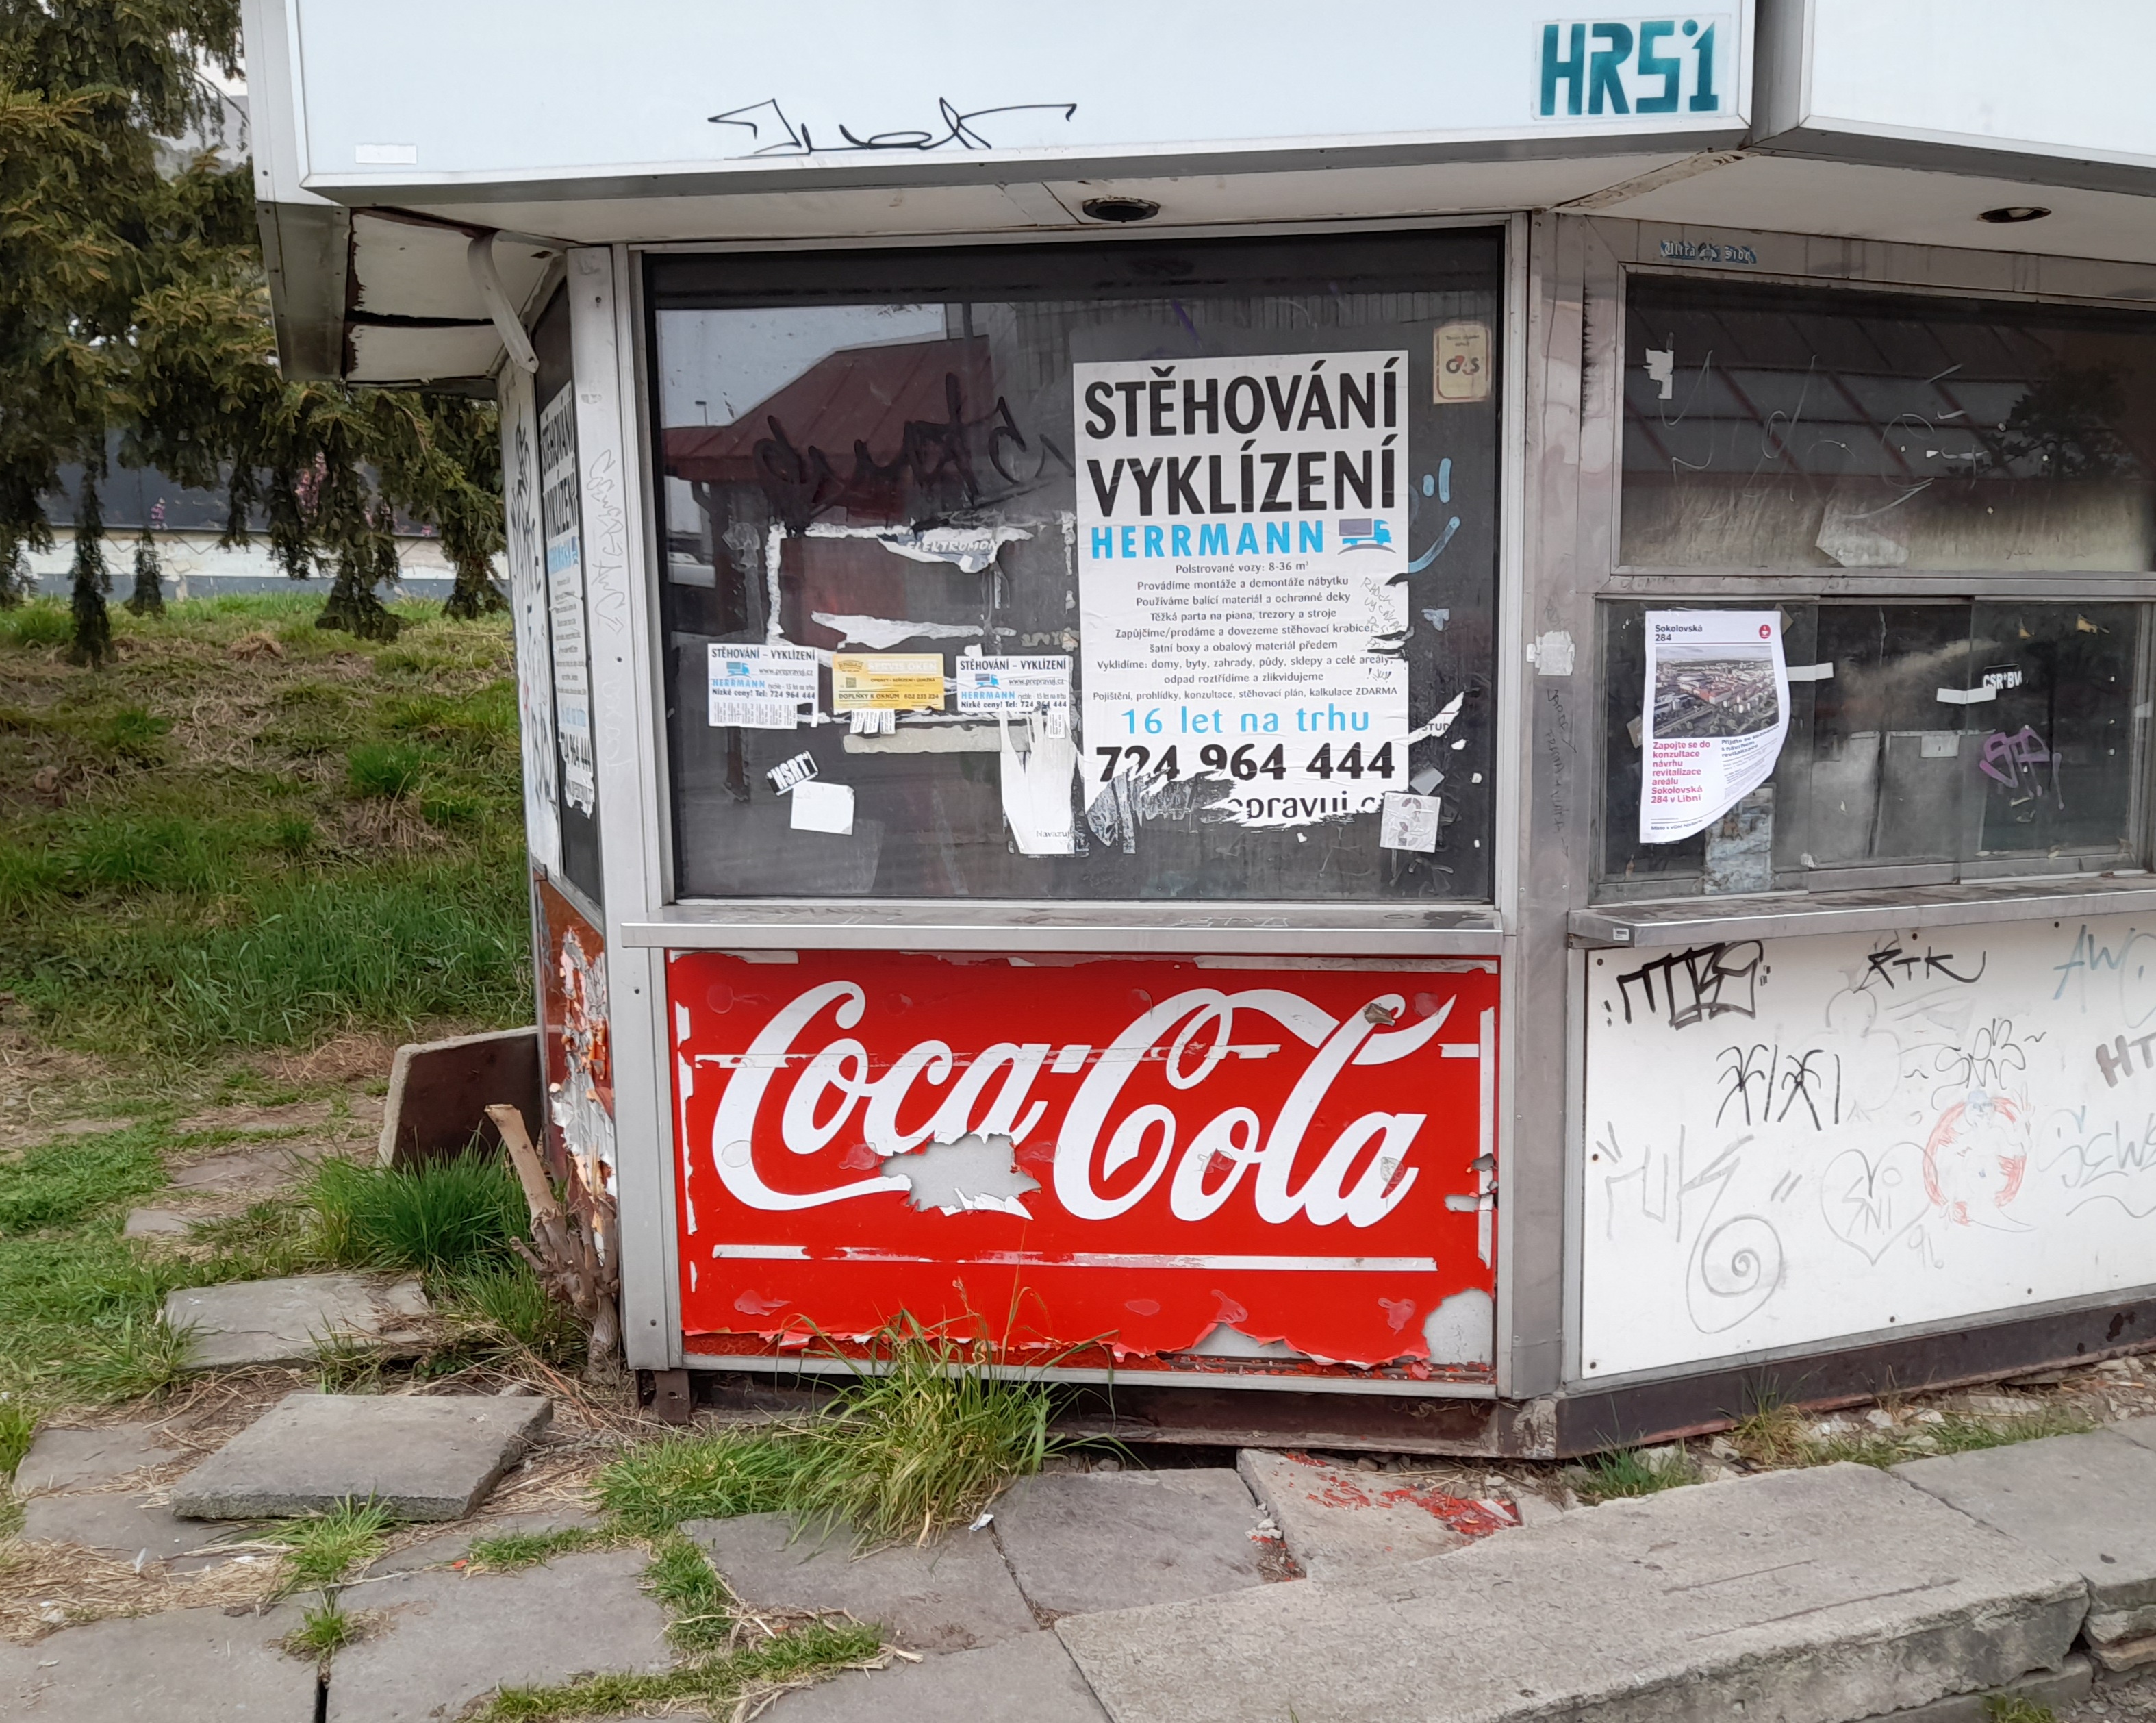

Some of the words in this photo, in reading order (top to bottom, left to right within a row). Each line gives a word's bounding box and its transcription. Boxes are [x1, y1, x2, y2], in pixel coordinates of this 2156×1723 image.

[1085, 357, 1400, 439] STĚHOVÁNÍ
[1087, 433, 1399, 517] VYKLÍZENÍ
[1091, 520, 1323, 559] HERRMANN
[1176, 564, 1235, 574] Polstrované
[1239, 563, 1265, 574] vozy:
[1268, 562, 1292, 572] 8-36
[1137, 581, 1191, 590] Provádíme
[1194, 579, 1236, 590] montáže
[1250, 577, 1305, 588] demontáže
[1308, 576, 1349, 588] nábytku
[1136, 596, 1189, 607] Používáme
[1193, 595, 1219, 605] balící
[1222, 594, 1263, 605] materiál
[1275, 593, 1323, 603] ochranné
[1326, 592, 1351, 604] deky
[1150, 612, 1178, 622] Těžká
[1181, 613, 1206, 623] parta
[1226, 611, 1255, 622] piana,
[1258, 611, 1295, 621] trezory
[1308, 608, 1336, 619] stroje
[1115, 627, 1215, 640] Zapůjčíme/prodáme
[1228, 625, 1278, 636] dovezeme
[1282, 624, 1330, 635] stěhovací
[1655, 624, 1703, 633] Sokolovská
[1655, 633, 1672, 642] 284
[712, 646, 760, 659] STĚHOVÁNÍ
[770, 648, 815, 661] VYKLÍZENÍ
[1150, 643, 1173, 653] šatní
[1176, 642, 1200, 654] boxy
[1213, 642, 1252, 654] obalový
[1255, 640, 1295, 651] materiál
[1299, 640, 1338, 652] předem
[960, 658, 1009, 670] STĚHOVÁNÍ
[1020, 658, 1067, 670] VYKLÍZENÍ
[1097, 659, 1148, 672] Vyklidíme:
[1151, 659, 1182, 670] domy,
[1185, 658, 1210, 670] byty,
[1213, 657, 1256, 669] zahrady,
[1259, 656, 1287, 668] půdy,
[1291, 656, 1323, 667] sklepy
[1335, 655, 1356, 665] celé
[1359, 654, 1393, 666] areály,
[713, 678, 765, 688] HERRMANN
[1009, 677, 1064, 686] www.prepravuj.cz
[1163, 674, 1195, 686] odpad
[1198, 673, 1250, 683] roztřídíme
[1262, 672, 1324, 683] zlikvidujeme
[734, 690, 753, 698] ceny!
[961, 690, 1015, 699] HERRMANN
[1093, 691, 1133, 702] Pojištění,
[1136, 690, 1181, 702] prohlídky,
[1184, 690, 1236, 700] konzultace,
[1239, 688, 1282, 699] stěhovací
[1284, 688, 1306, 699] plán,
[1310, 687, 1353, 697] kalkulace
[1356, 687, 1398, 696] ZDARMA
[983, 701, 1002, 710] ceny!
[1121, 708, 1163, 735] 16
[1180, 706, 1223, 733] let
[1241, 712, 1280, 733] na
[1296, 703, 1369, 732] trhu
[1653, 741, 1686, 751] Zapojte
[1699, 740, 1710, 749] do
[1200, 742, 1286, 781] 964
[1306, 741, 1395, 780] 444
[1652, 768, 1701, 777] revitalizace
[1651, 777, 1679, 785] areálu
[1651, 785, 1703, 795] Sokolovská
[1651, 795, 1668, 803] 284
[711, 980, 1459, 1228] Coca-Cola
